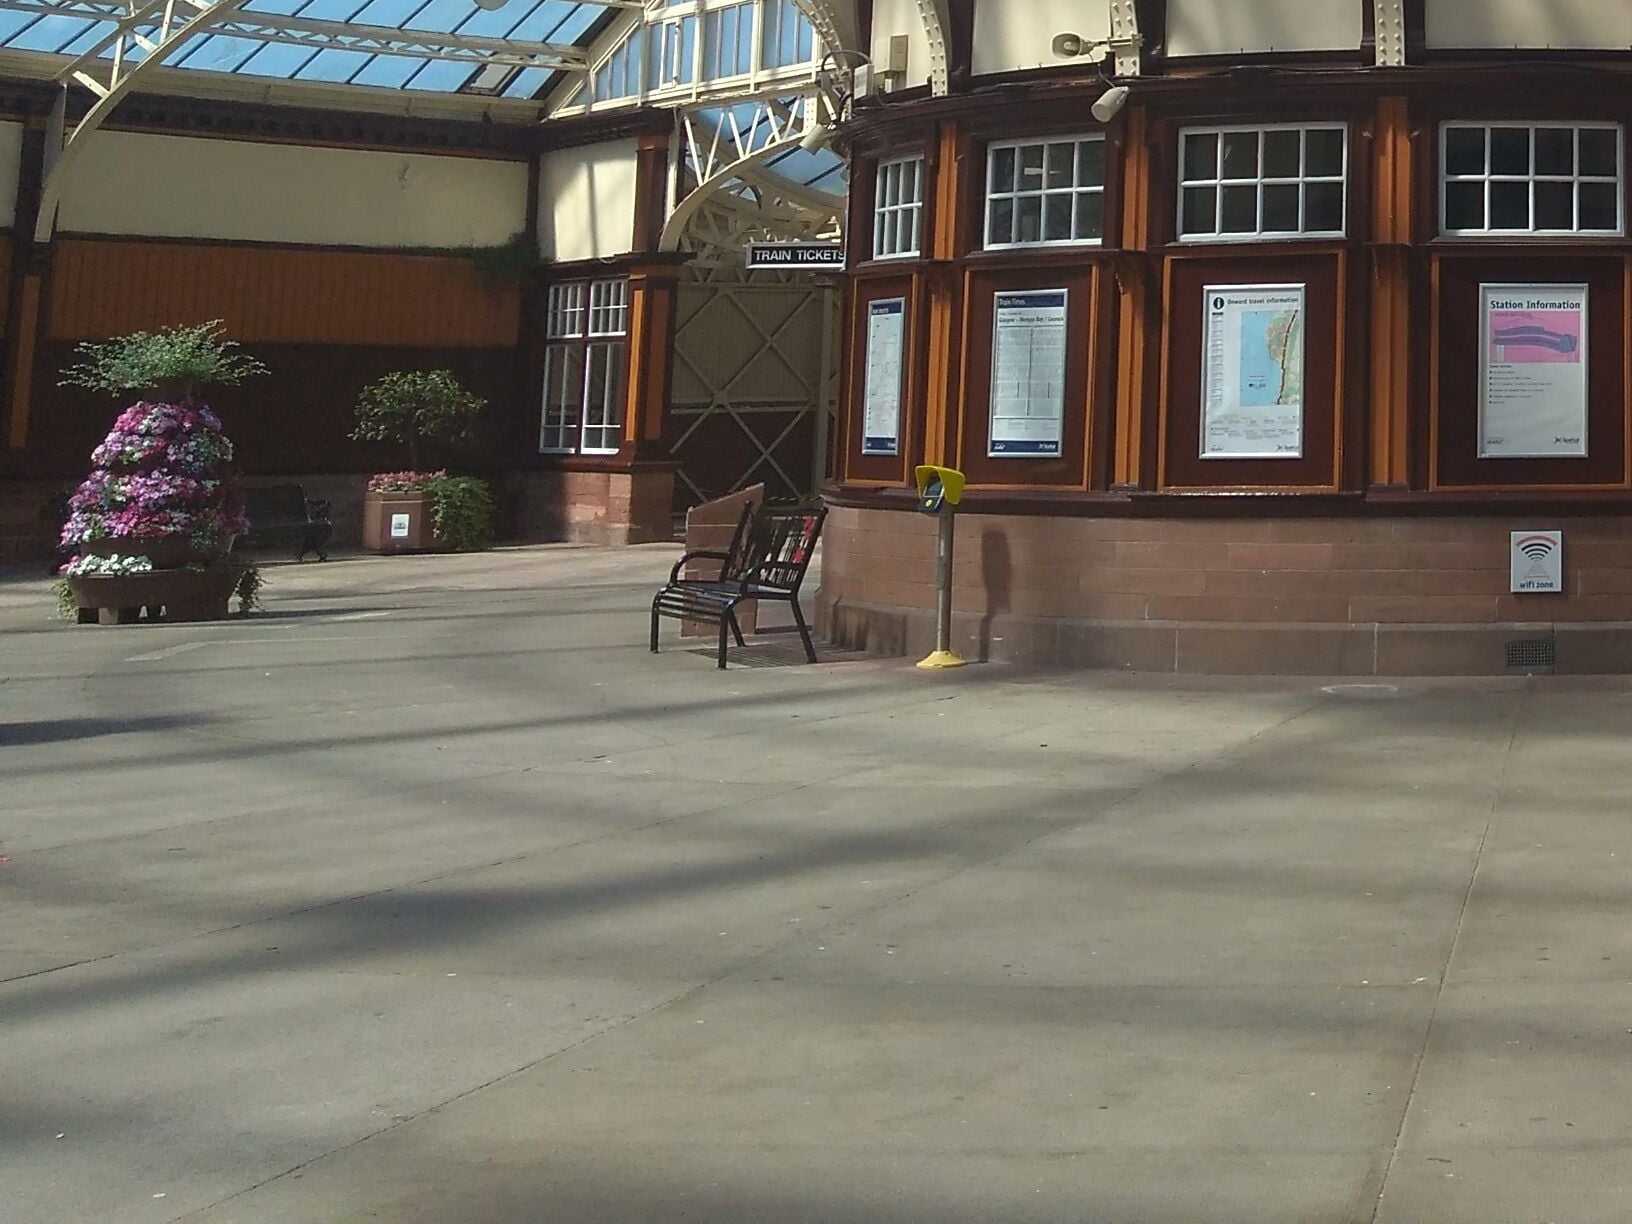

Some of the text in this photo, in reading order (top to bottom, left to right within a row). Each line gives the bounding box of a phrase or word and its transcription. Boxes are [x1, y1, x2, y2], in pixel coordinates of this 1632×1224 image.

[755, 250, 845, 261] TRAIN TICKETS
[1490, 300, 1580, 309] Station Information
[1520, 580, 1535, 588] wifi
